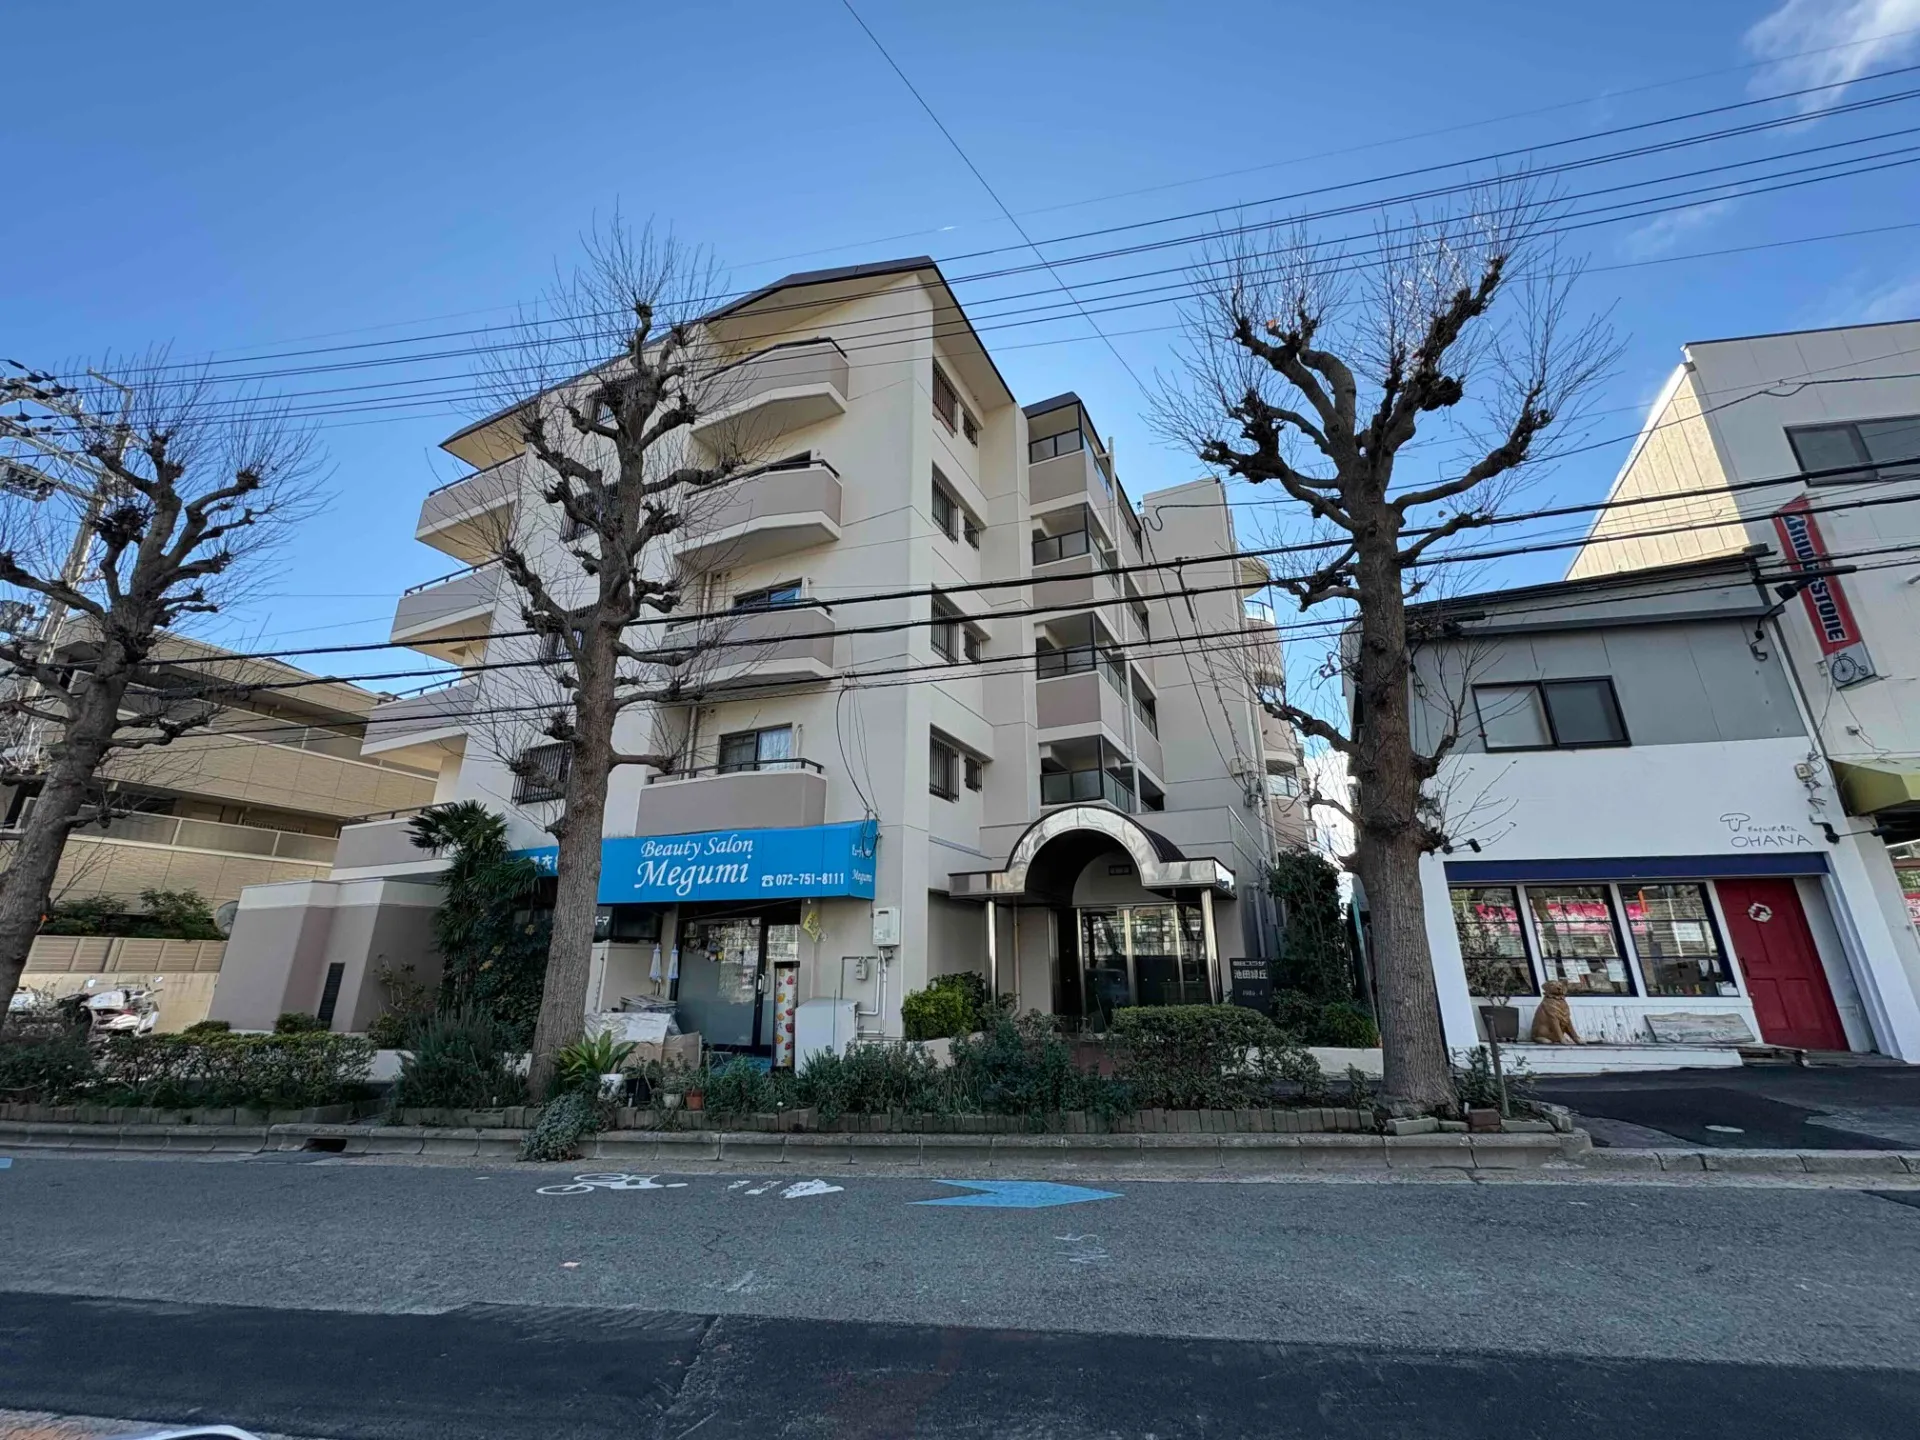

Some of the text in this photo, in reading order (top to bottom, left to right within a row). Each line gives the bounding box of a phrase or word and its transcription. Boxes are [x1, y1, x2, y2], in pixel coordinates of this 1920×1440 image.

[641, 834, 753, 861] Beauty Salon
[1731, 834, 1813, 848] OHANA
[634, 855, 752, 896] Megumi
[776, 872, 844, 886] 072-751-8111
